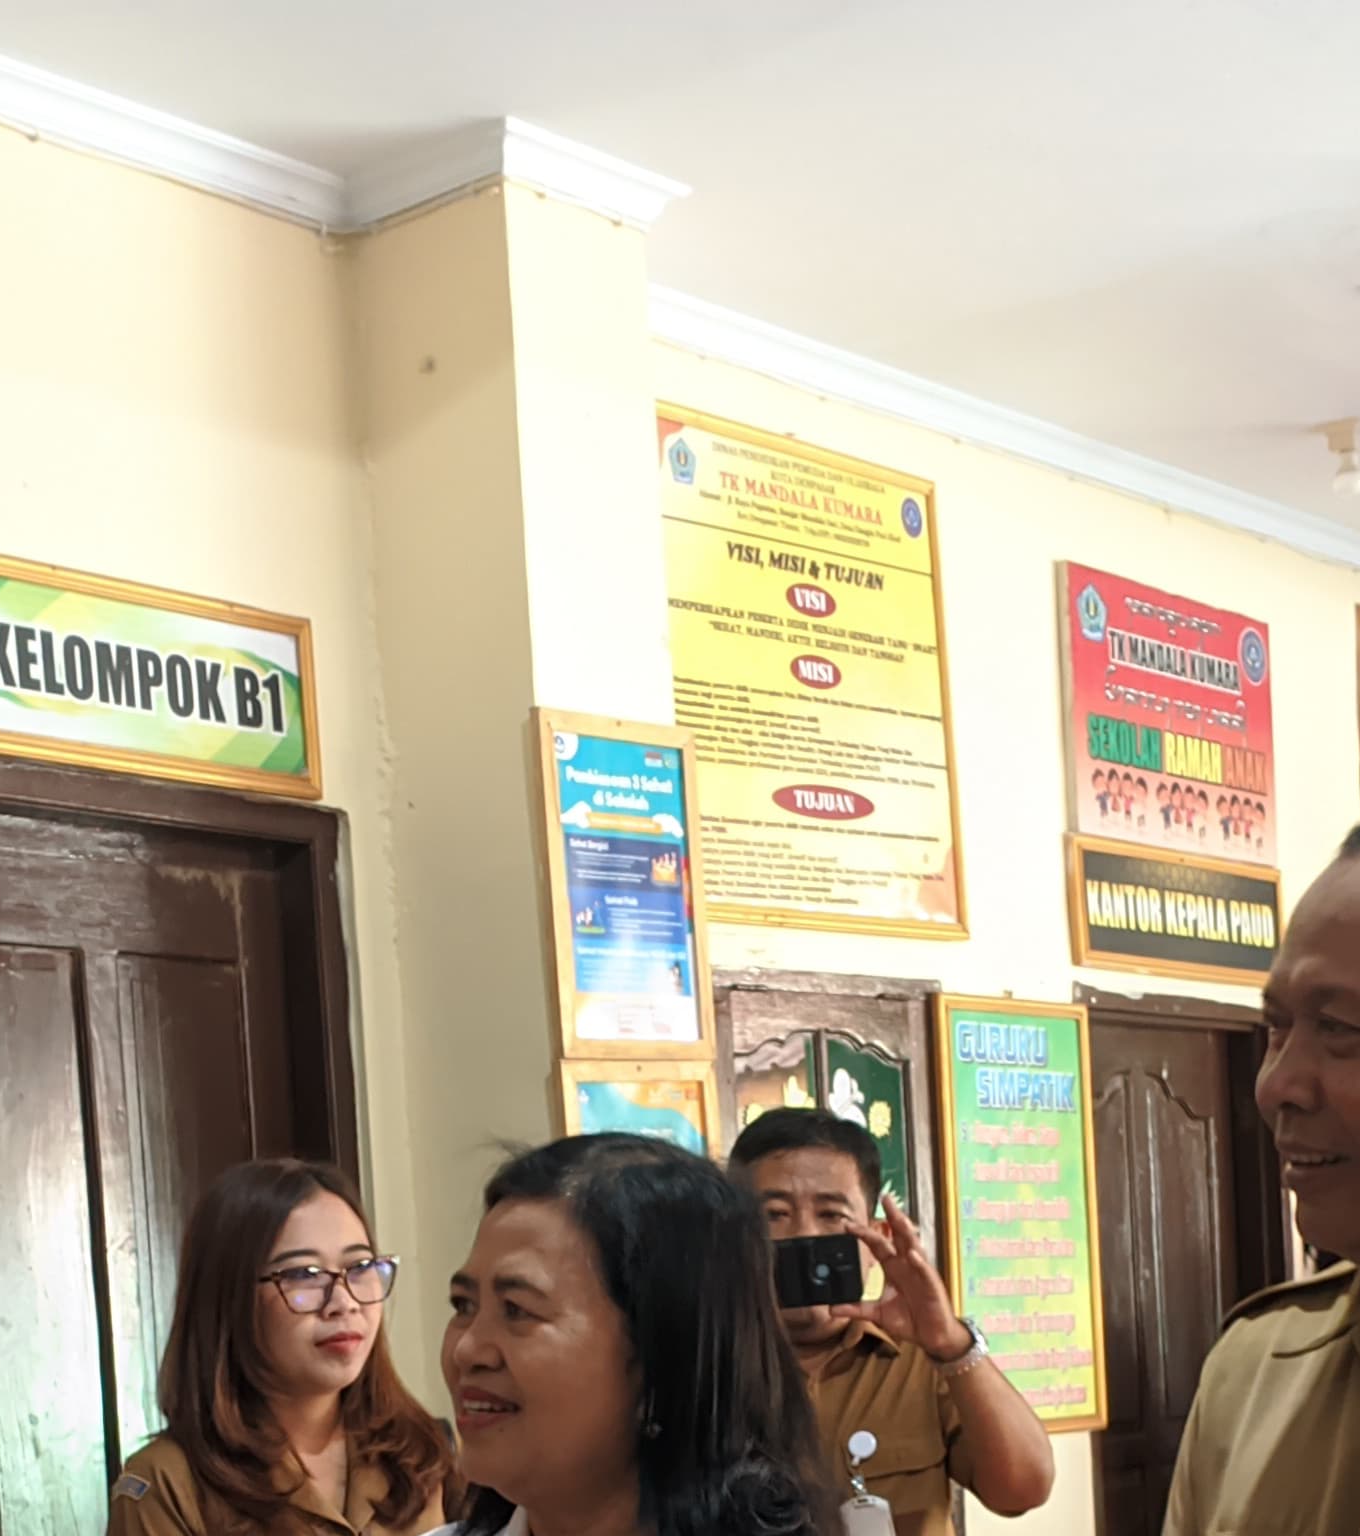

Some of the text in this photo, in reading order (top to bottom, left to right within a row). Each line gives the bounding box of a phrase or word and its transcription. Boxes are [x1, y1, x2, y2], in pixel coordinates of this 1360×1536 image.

[719, 471, 740, 493] TK
[744, 476, 819, 511] MANDALA
[824, 494, 883, 527] KUMARA
[727, 541, 885, 591] VISI, MISI & TUJUAN
[794, 586, 827, 613] VISI
[798, 659, 834, 685] MISI
[1108, 629, 1126, 662] TK
[1128, 635, 1187, 680] MANDALA
[234, 666, 284, 734] B1
[1088, 713, 1267, 796] SEKOLAH RAMAH ANAK
[793, 789, 856, 815] TUJUAN
[1086, 879, 1276, 949] KANTOR KEPALA PAUD
[976, 1067, 1077, 1112] SIMPATIK
